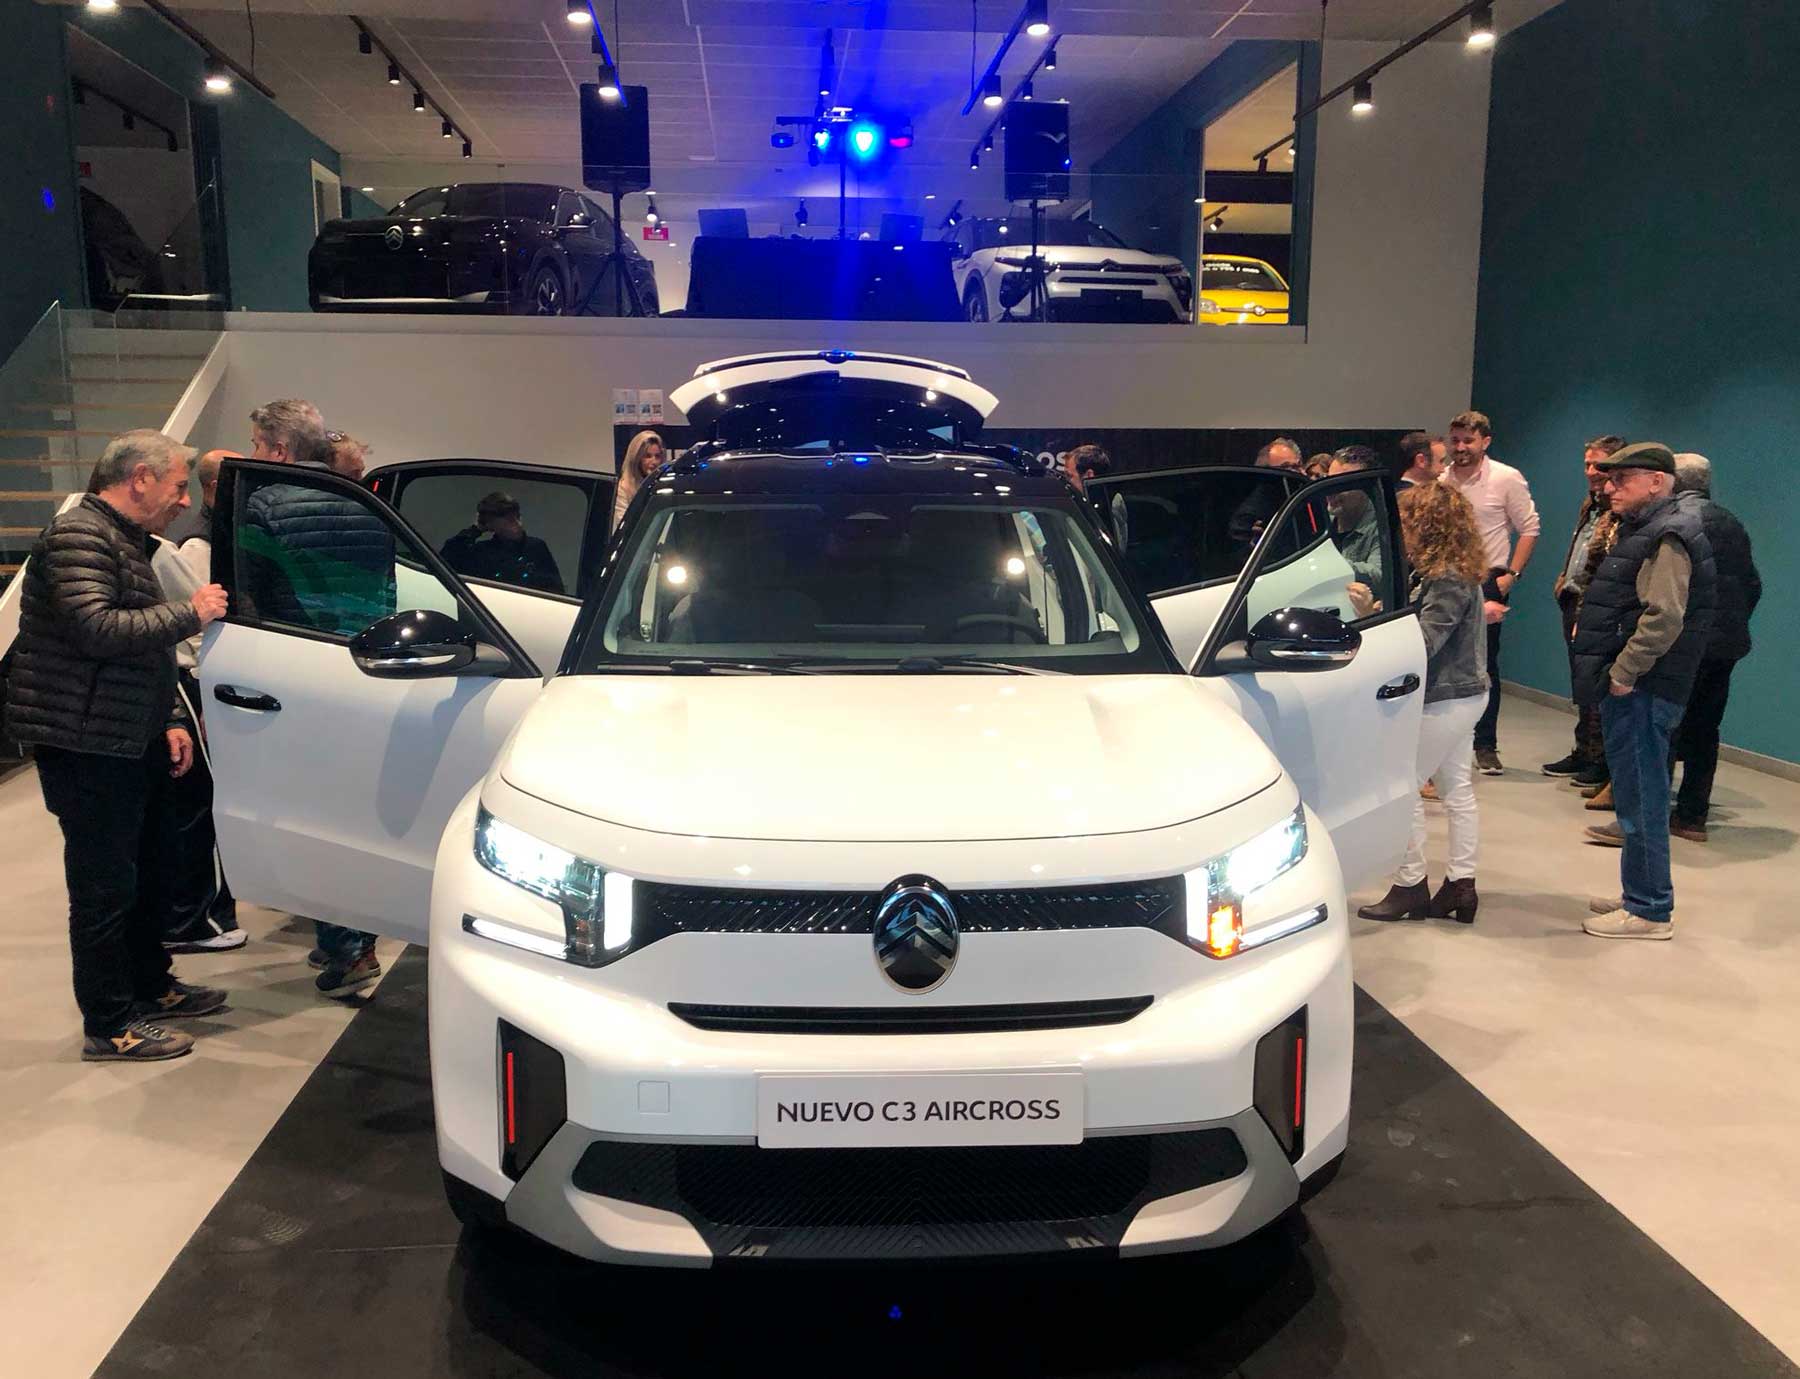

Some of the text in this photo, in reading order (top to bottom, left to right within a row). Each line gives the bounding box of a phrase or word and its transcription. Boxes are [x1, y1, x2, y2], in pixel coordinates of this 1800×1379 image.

[777, 1099, 1061, 1123] NUEVO C3 AIRCROSS
